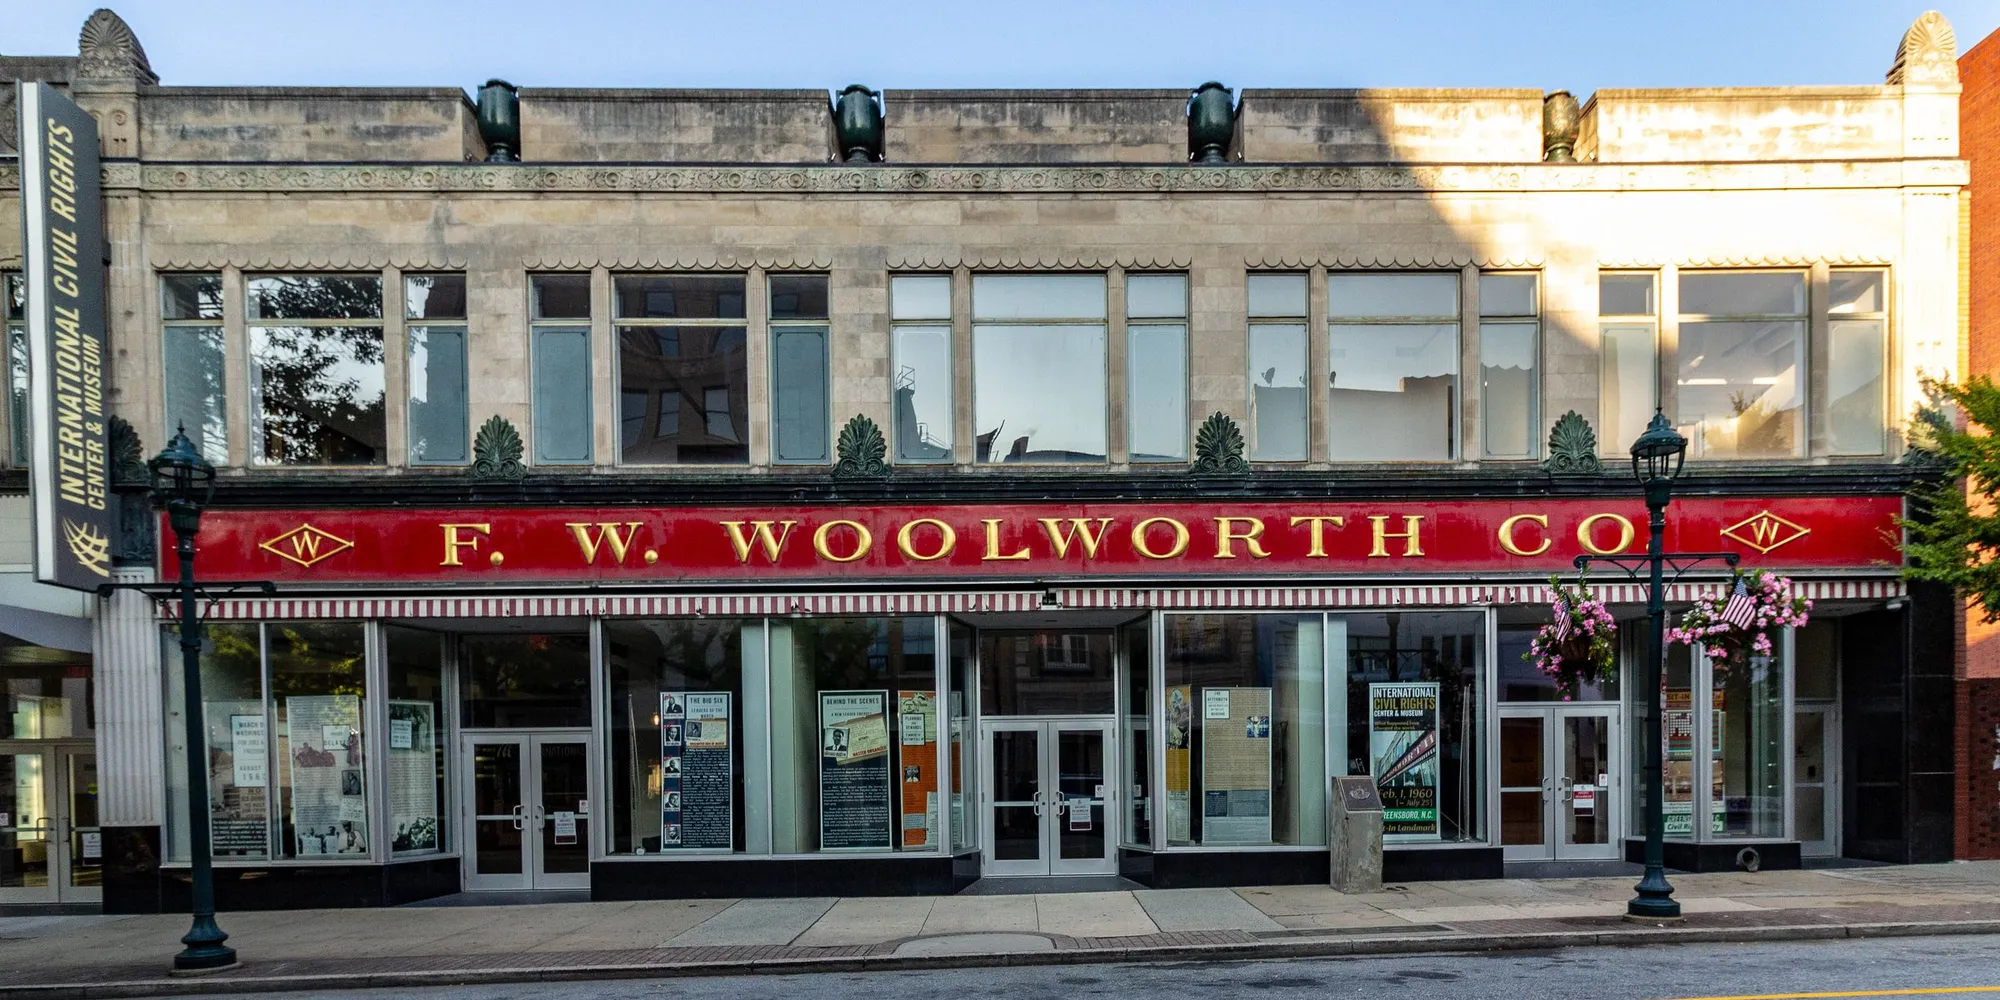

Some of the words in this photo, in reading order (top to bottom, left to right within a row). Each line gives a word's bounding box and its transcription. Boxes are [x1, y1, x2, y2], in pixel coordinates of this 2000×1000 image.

[47, 117, 76, 223] RIGHTS
[51, 227, 80, 298] CIVIL
[82, 333, 102, 417] MUSEUM
[54, 305, 85, 505] INTERNATIONAL
[85, 421, 103, 436] &
[85, 438, 106, 511] CENTER
[439, 523, 504, 566] F.
[565, 522, 658, 565] W.
[719, 515, 1426, 563] WOOLWORTH
[1497, 513, 1649, 556] CO
[1750, 521, 1780, 546] W
[291, 531, 323, 559] W
[859, 697, 880, 705] SCENES
[1373, 687, 1436, 698] INTERNATIONAL
[1374, 698, 1399, 710] CIVIL
[1400, 698, 1435, 710] RIGHTS
[1406, 799, 1420, 808] July
[1409, 788, 1433, 799] 1960
[1383, 810, 1419, 820] REENSBORO,
[1420, 810, 1434, 819] N.C.
[1397, 823, 1436, 832] Landmark
